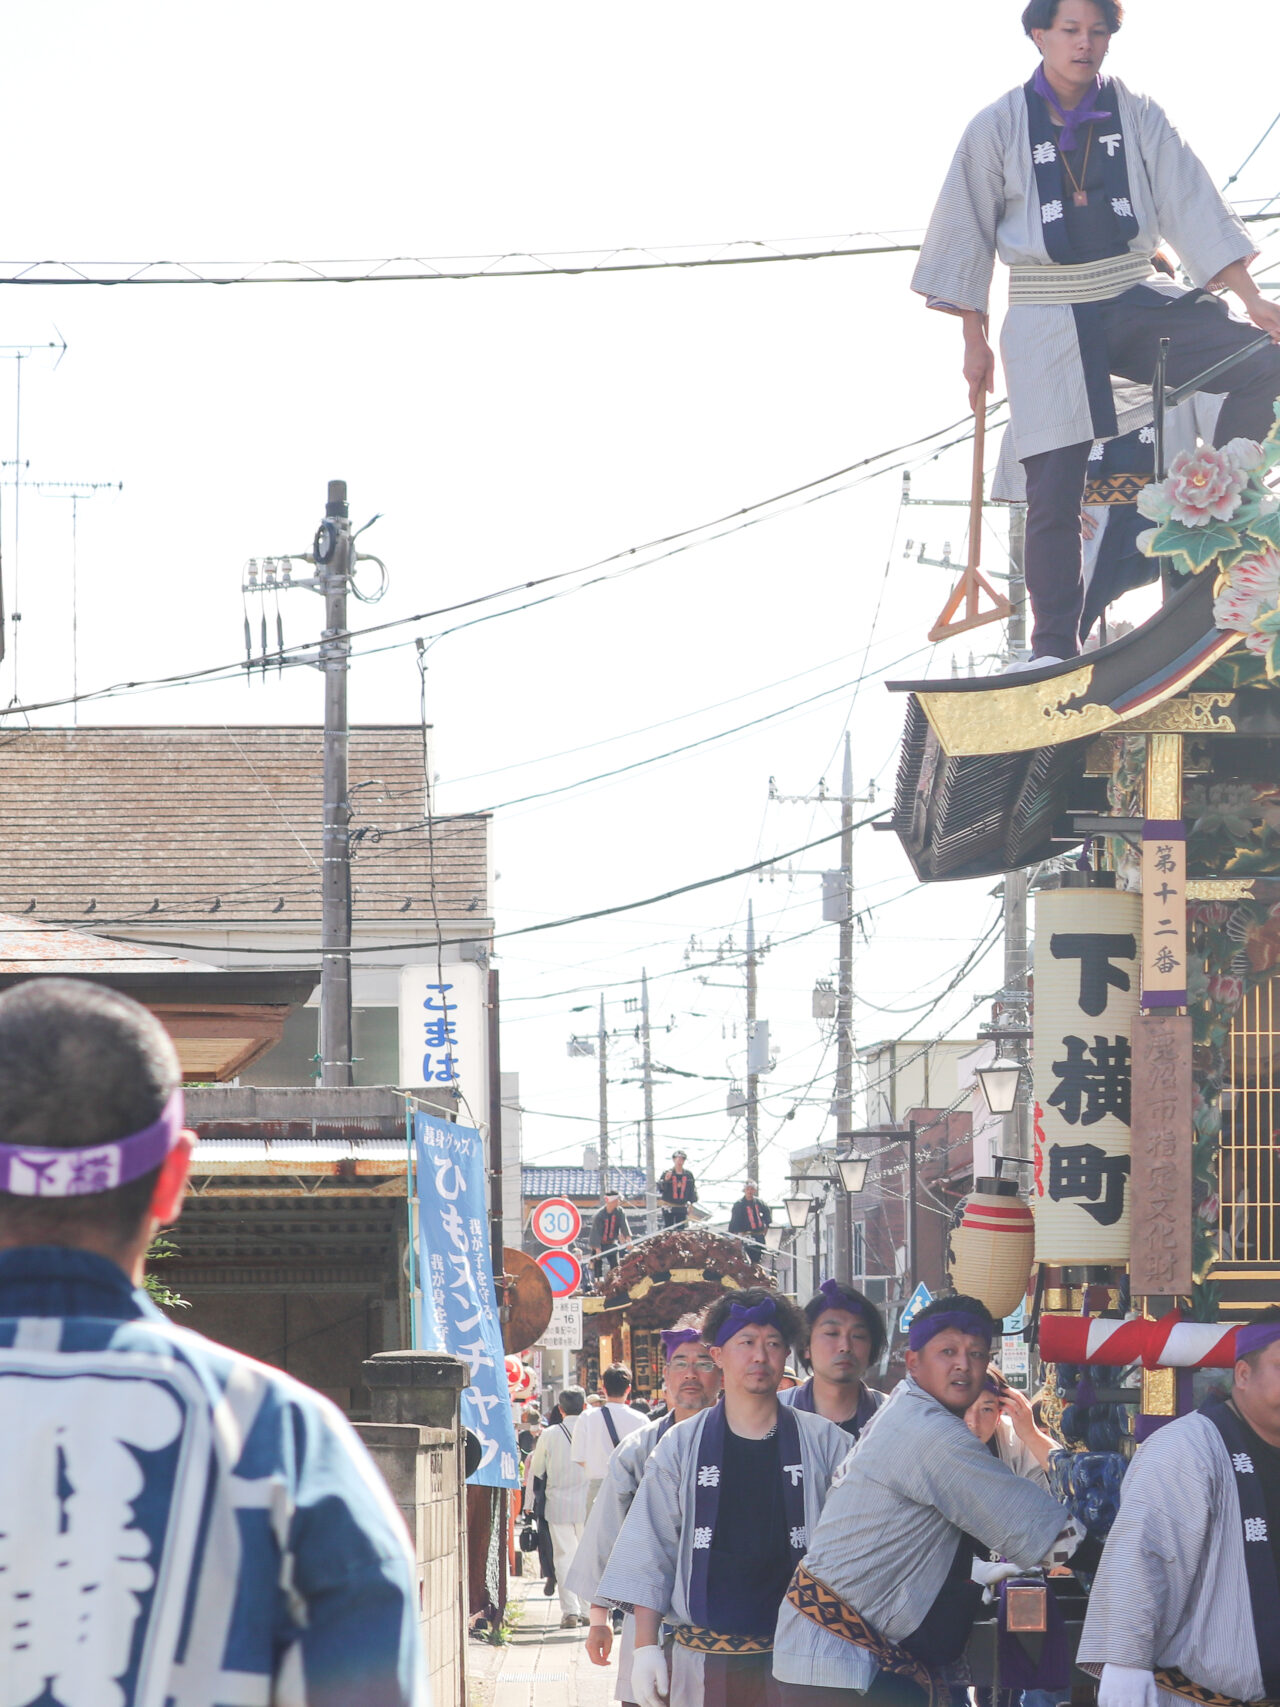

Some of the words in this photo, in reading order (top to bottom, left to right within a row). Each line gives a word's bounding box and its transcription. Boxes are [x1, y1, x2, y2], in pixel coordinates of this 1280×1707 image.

[1098, 133, 1133, 217] 下横
[1151, 844, 1181, 975] 第十二番
[423, 983, 461, 1082] こまは
[1047, 932, 1137, 1227] 下横町
[1143, 1030, 1180, 1284] 鹿沼市指定文化財
[544, 1213, 570, 1233] 30
[434, 1154, 499, 1470] ひもヌンチャク
